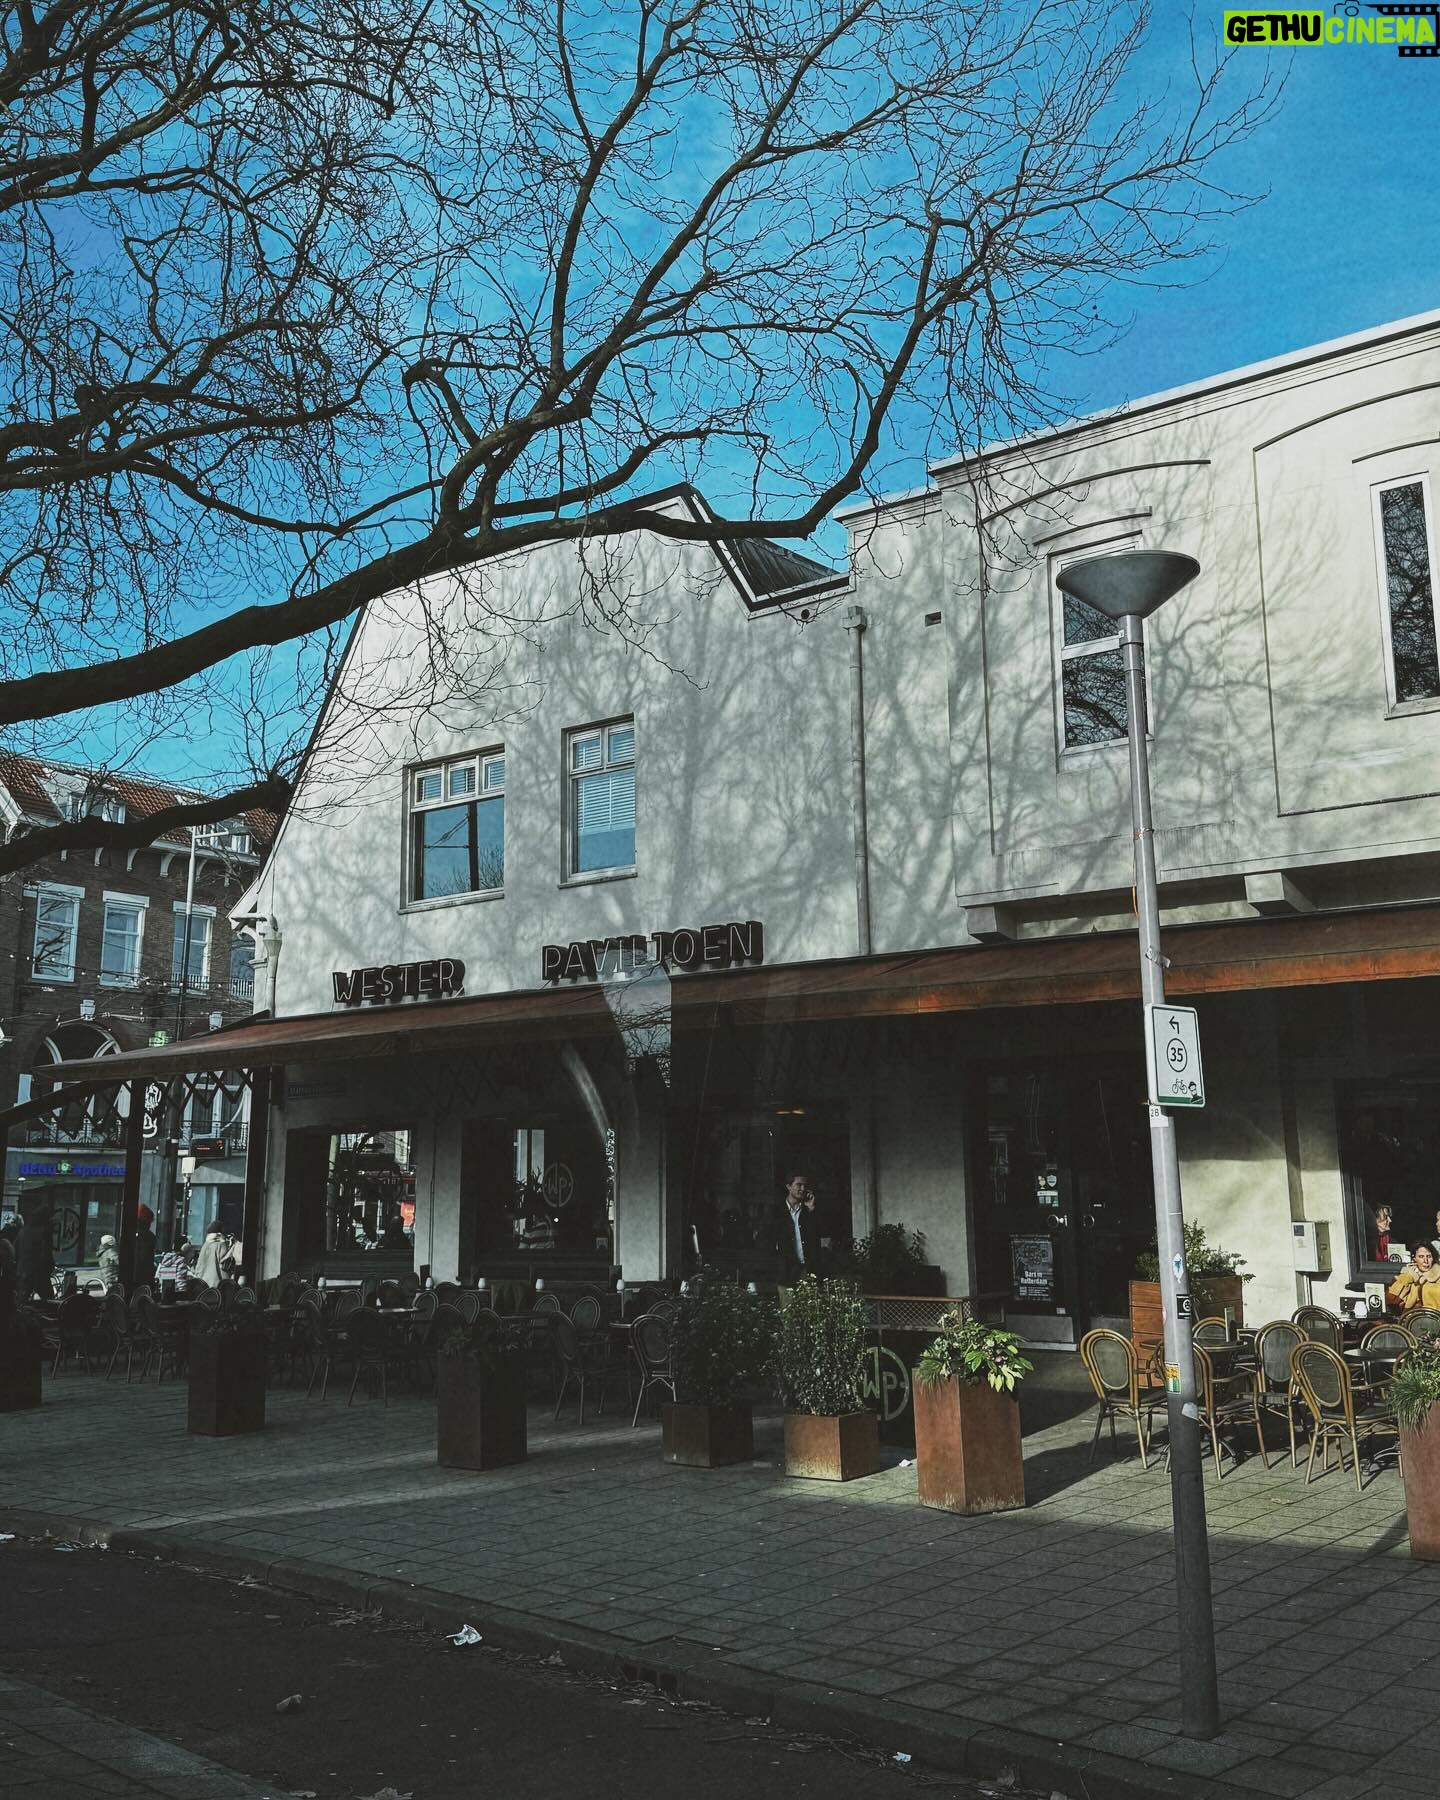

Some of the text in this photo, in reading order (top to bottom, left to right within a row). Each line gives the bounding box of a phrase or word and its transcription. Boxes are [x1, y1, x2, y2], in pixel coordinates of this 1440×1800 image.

[333, 921, 764, 1005] WESTER PAVILJOEN
[1170, 1047, 1184, 1063] 35
